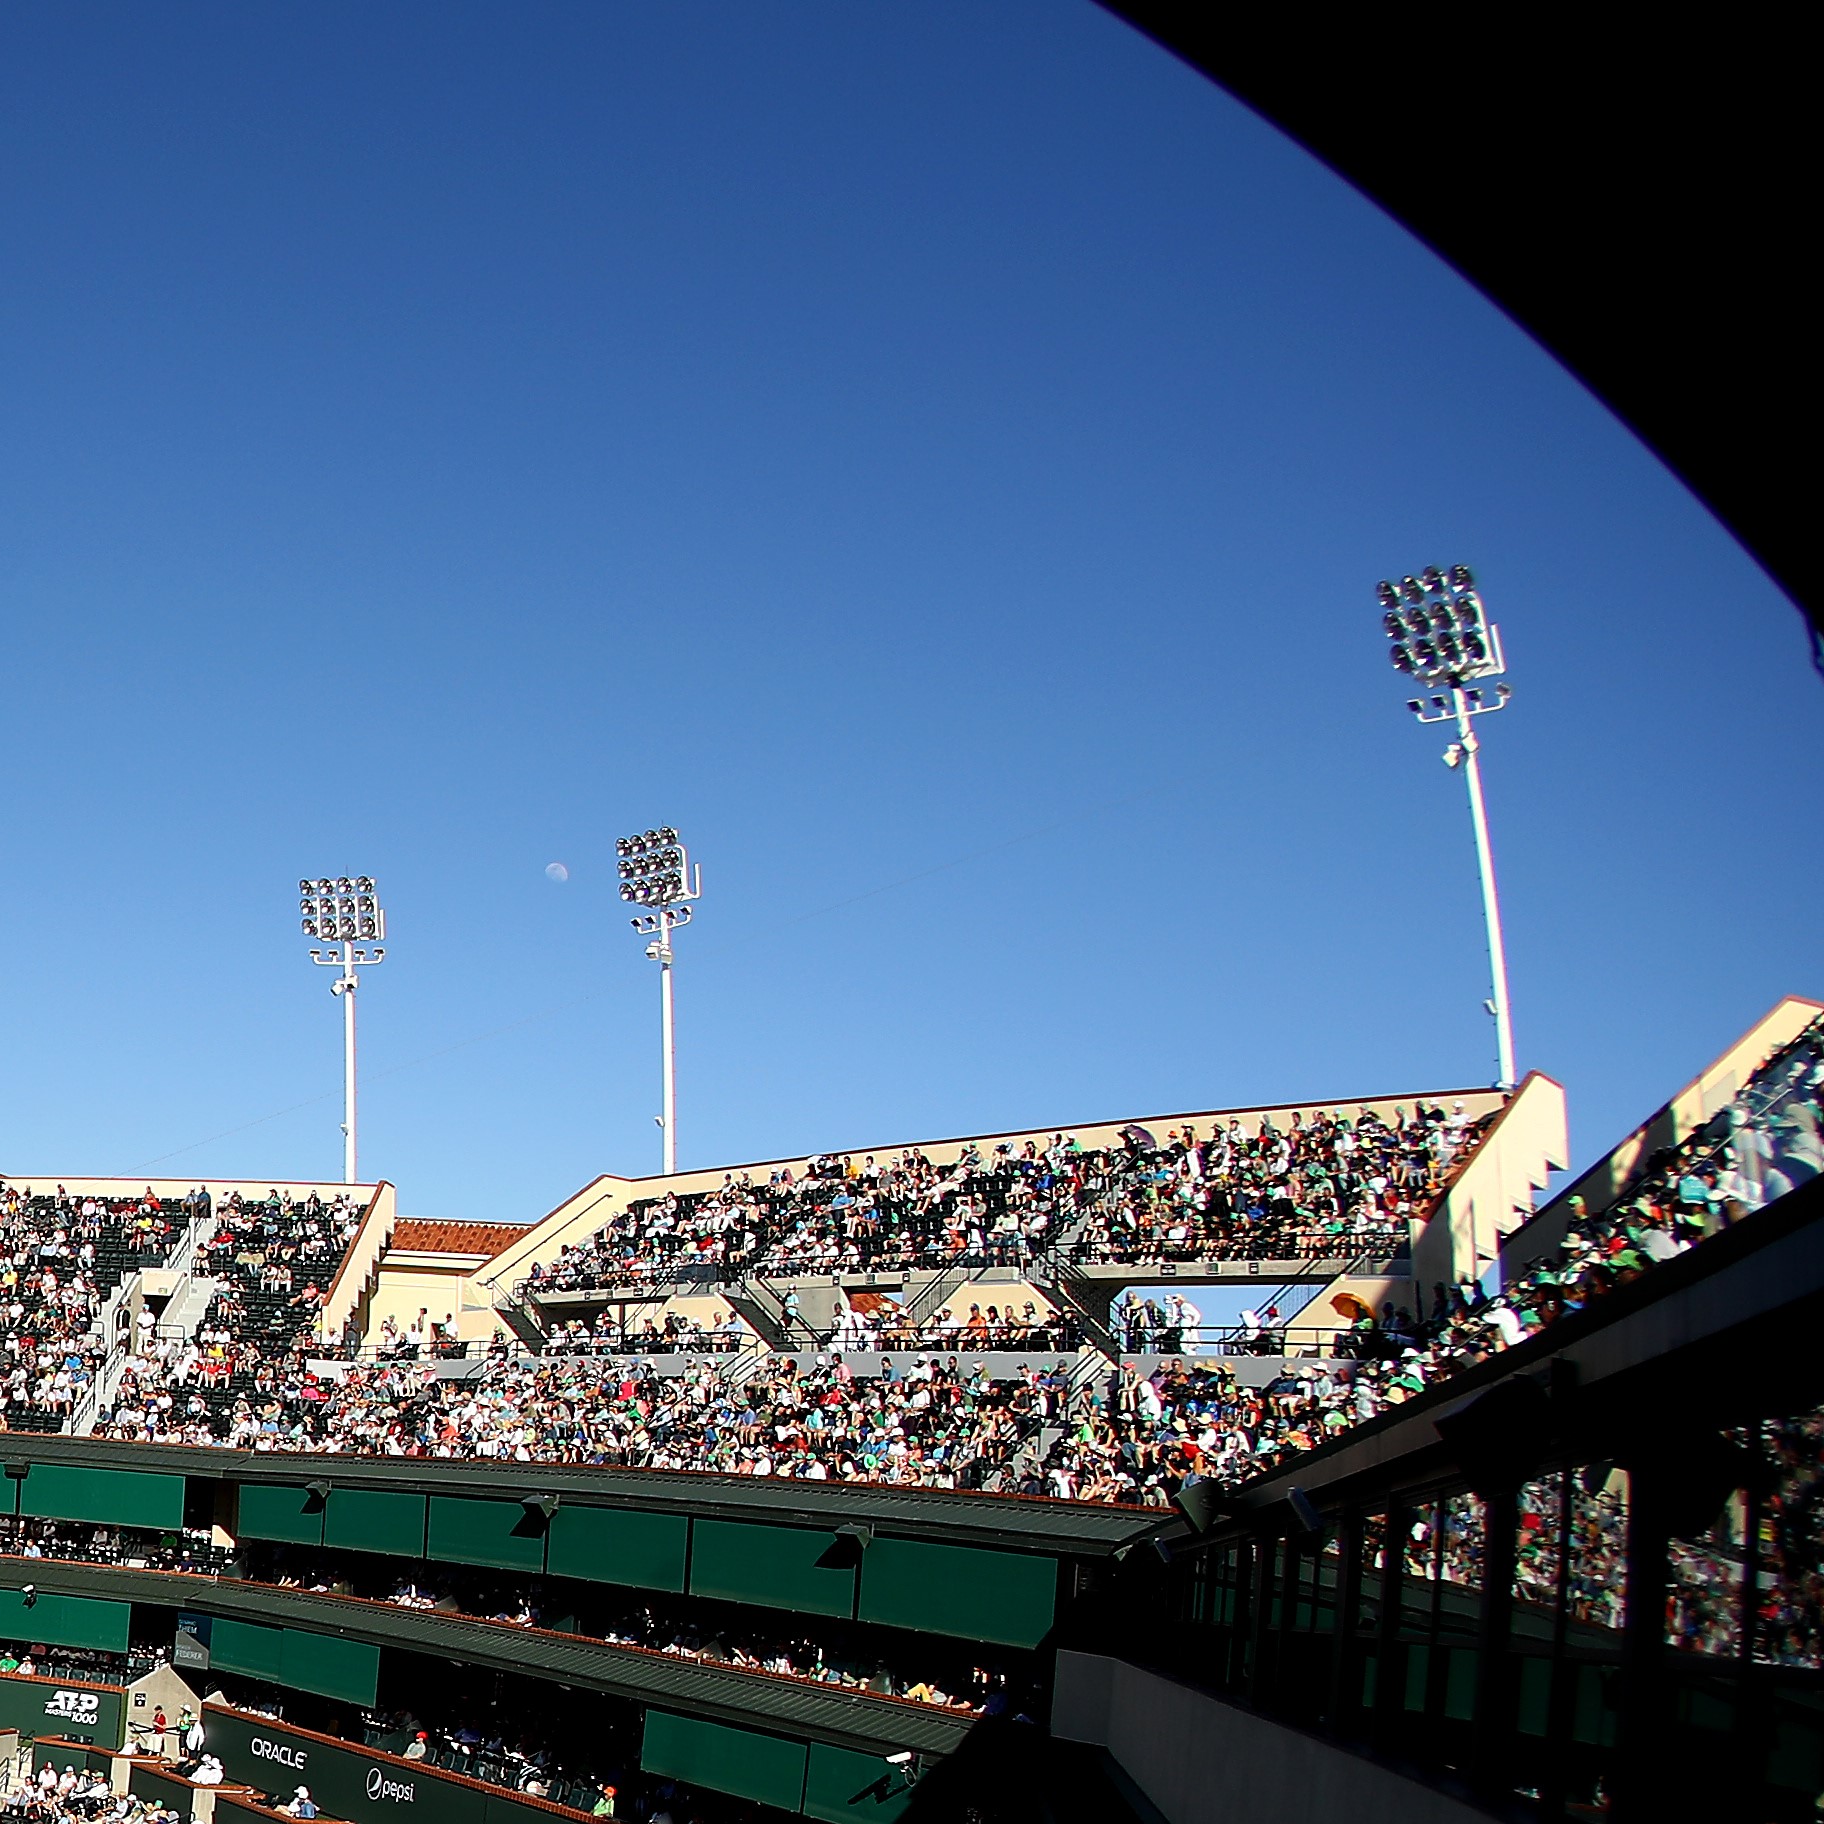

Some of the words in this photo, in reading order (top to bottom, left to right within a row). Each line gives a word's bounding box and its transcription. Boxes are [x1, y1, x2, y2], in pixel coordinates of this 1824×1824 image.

[44, 1690, 99, 1713] ATP
[71, 1711, 98, 1725] 1000
[251, 1737, 308, 1770] ORACLE
[381, 1779, 415, 1803] pepsi
